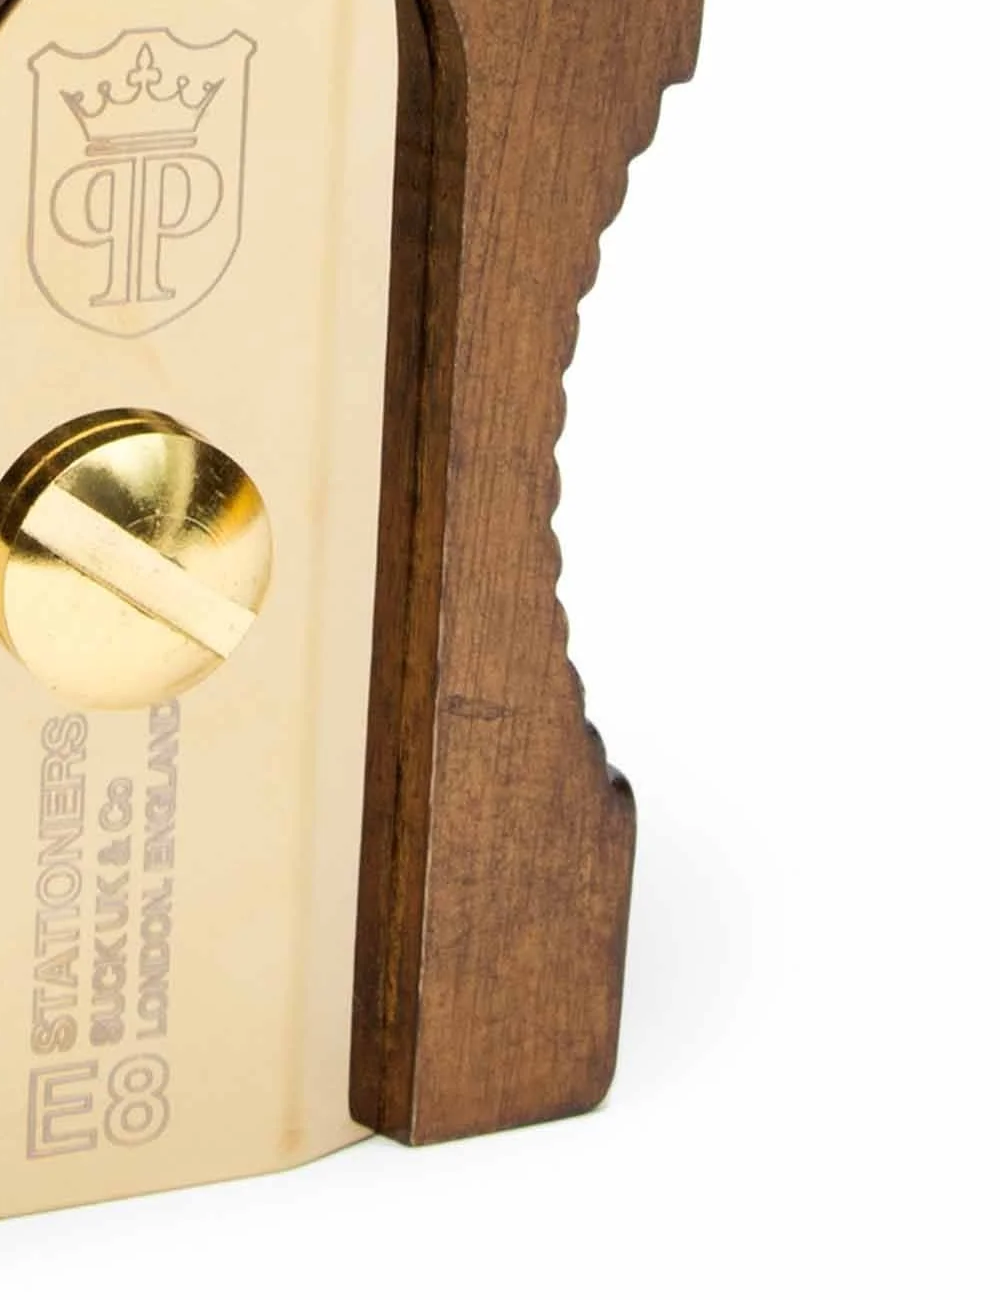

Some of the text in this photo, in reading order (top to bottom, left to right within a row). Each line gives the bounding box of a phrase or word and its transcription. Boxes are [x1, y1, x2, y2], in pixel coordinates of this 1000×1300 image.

[30, 713, 89, 1054] STATIONERS
[89, 777, 133, 1046] SUCK UK & Co
[143, 698, 180, 872] ENGLAND
